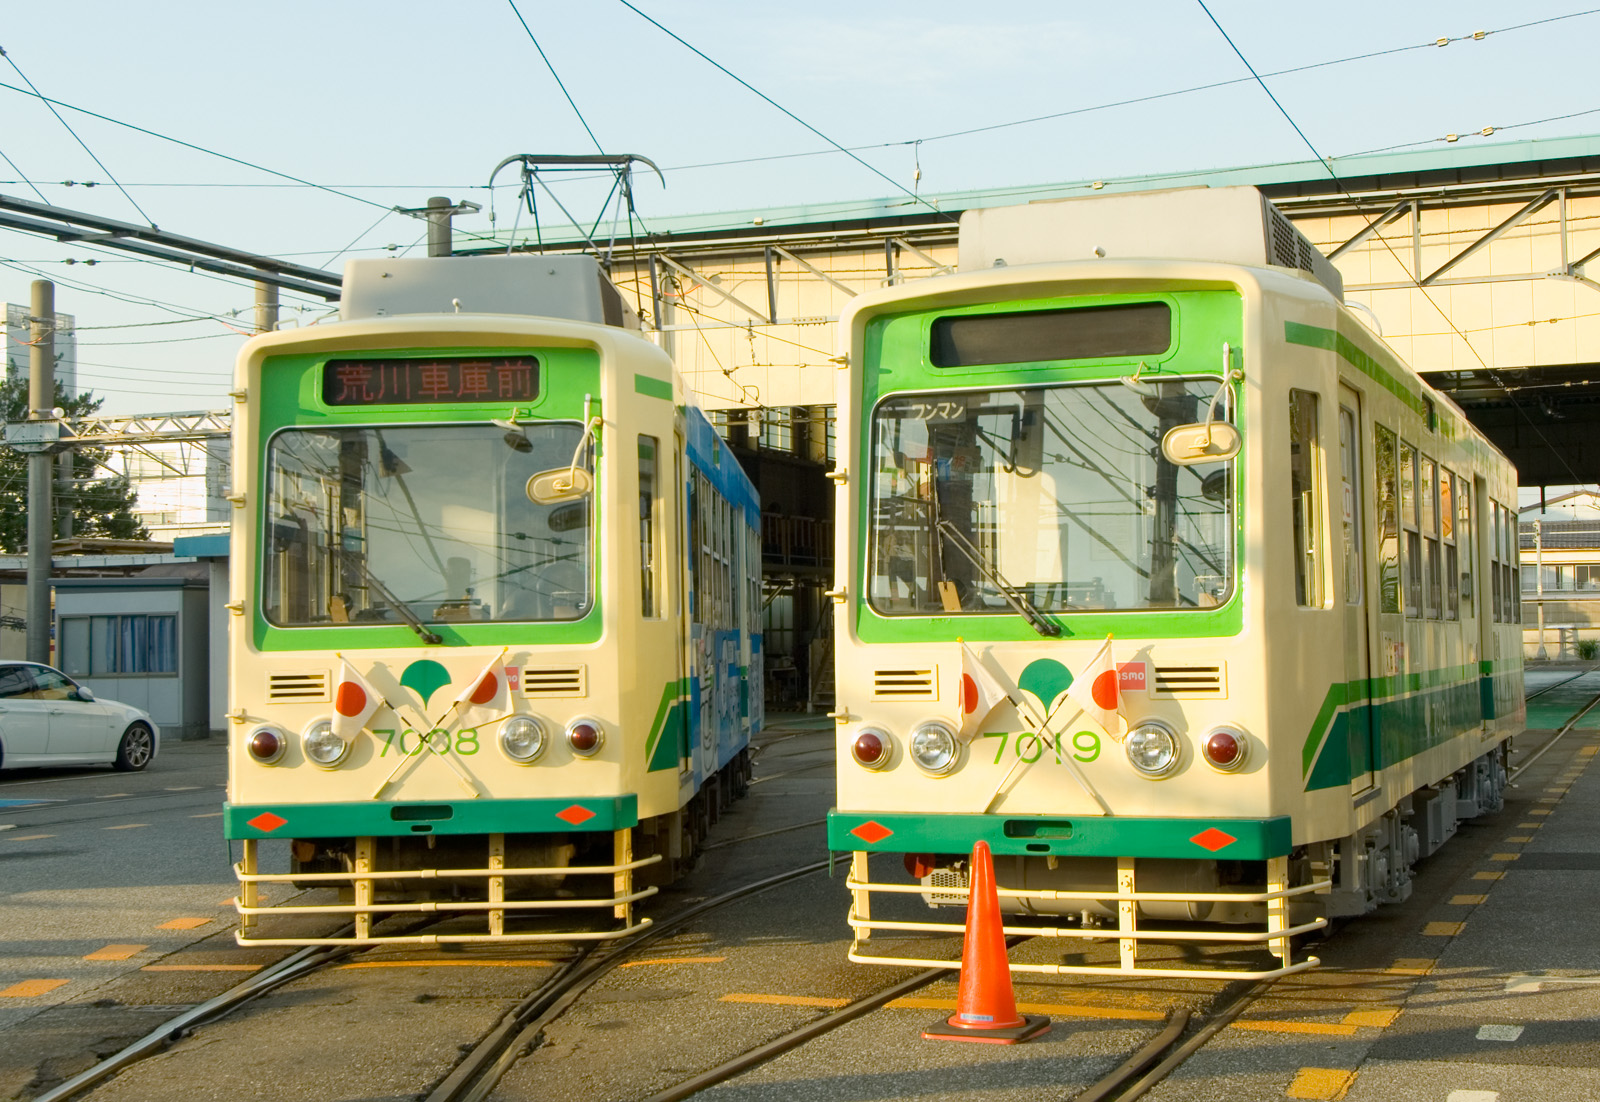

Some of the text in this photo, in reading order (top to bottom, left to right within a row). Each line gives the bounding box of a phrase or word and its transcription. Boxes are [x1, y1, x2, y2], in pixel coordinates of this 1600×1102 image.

[336, 361, 532, 401] 荒川車庫前
[911, 402, 964, 420] ワンマン
[372, 728, 480, 758] 7008
[983, 730, 1101, 765] 7019
